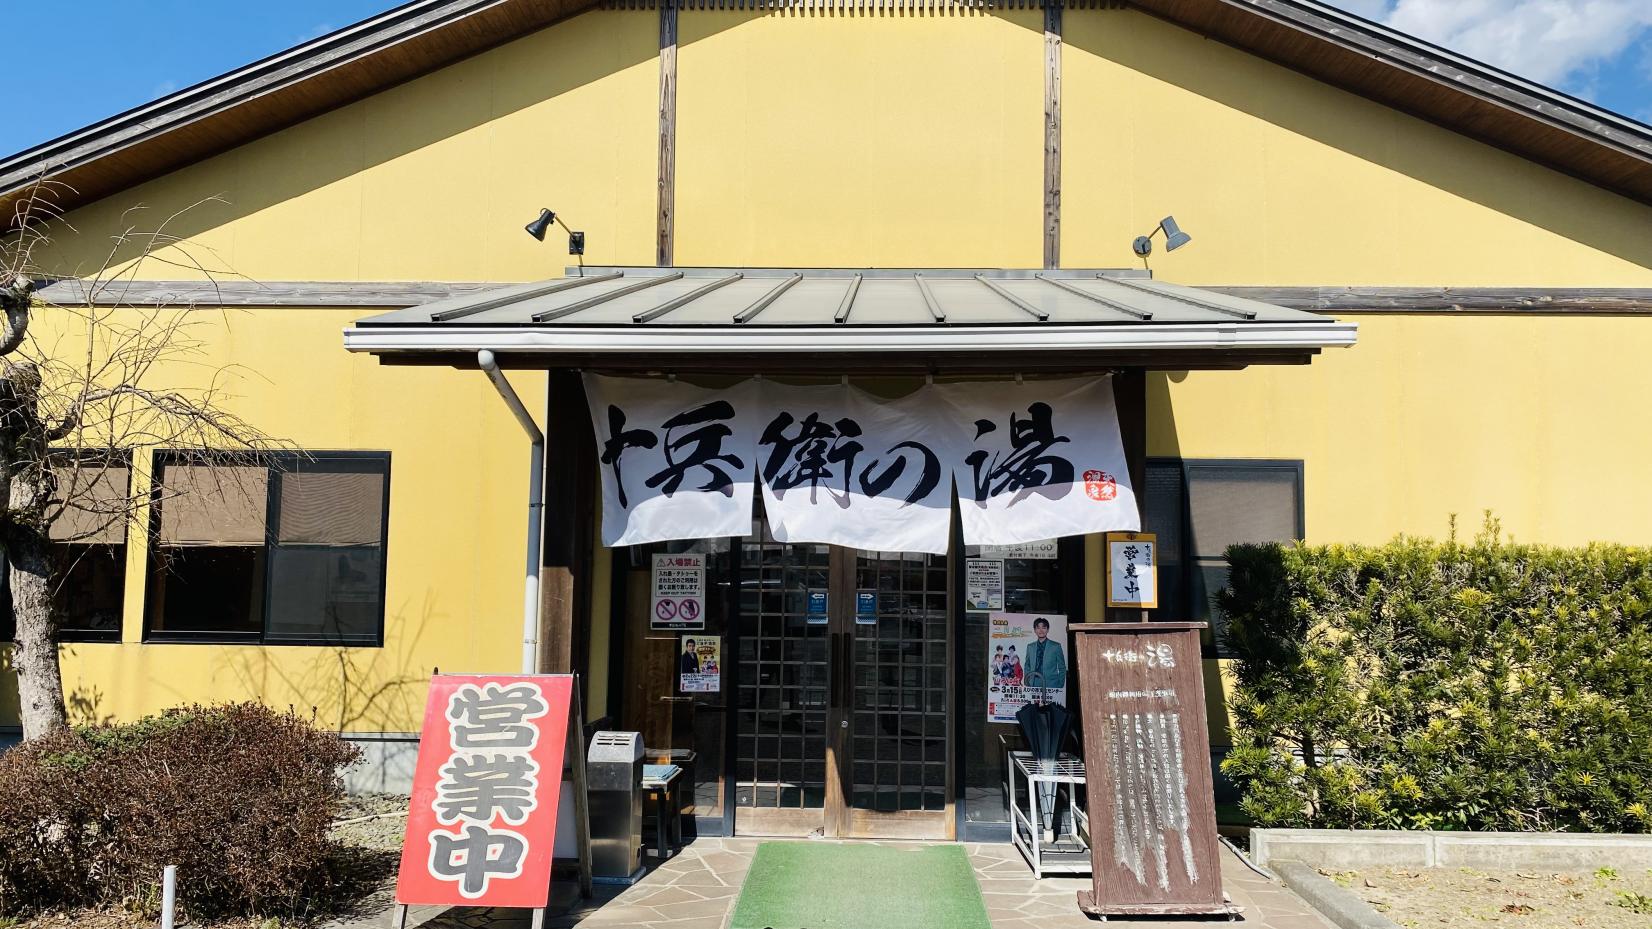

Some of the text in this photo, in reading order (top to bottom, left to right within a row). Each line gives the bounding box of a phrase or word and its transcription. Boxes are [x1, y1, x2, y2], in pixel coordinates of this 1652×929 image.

[667, 557, 701, 567] 入場禁止
[430, 684, 547, 896] 営業中
